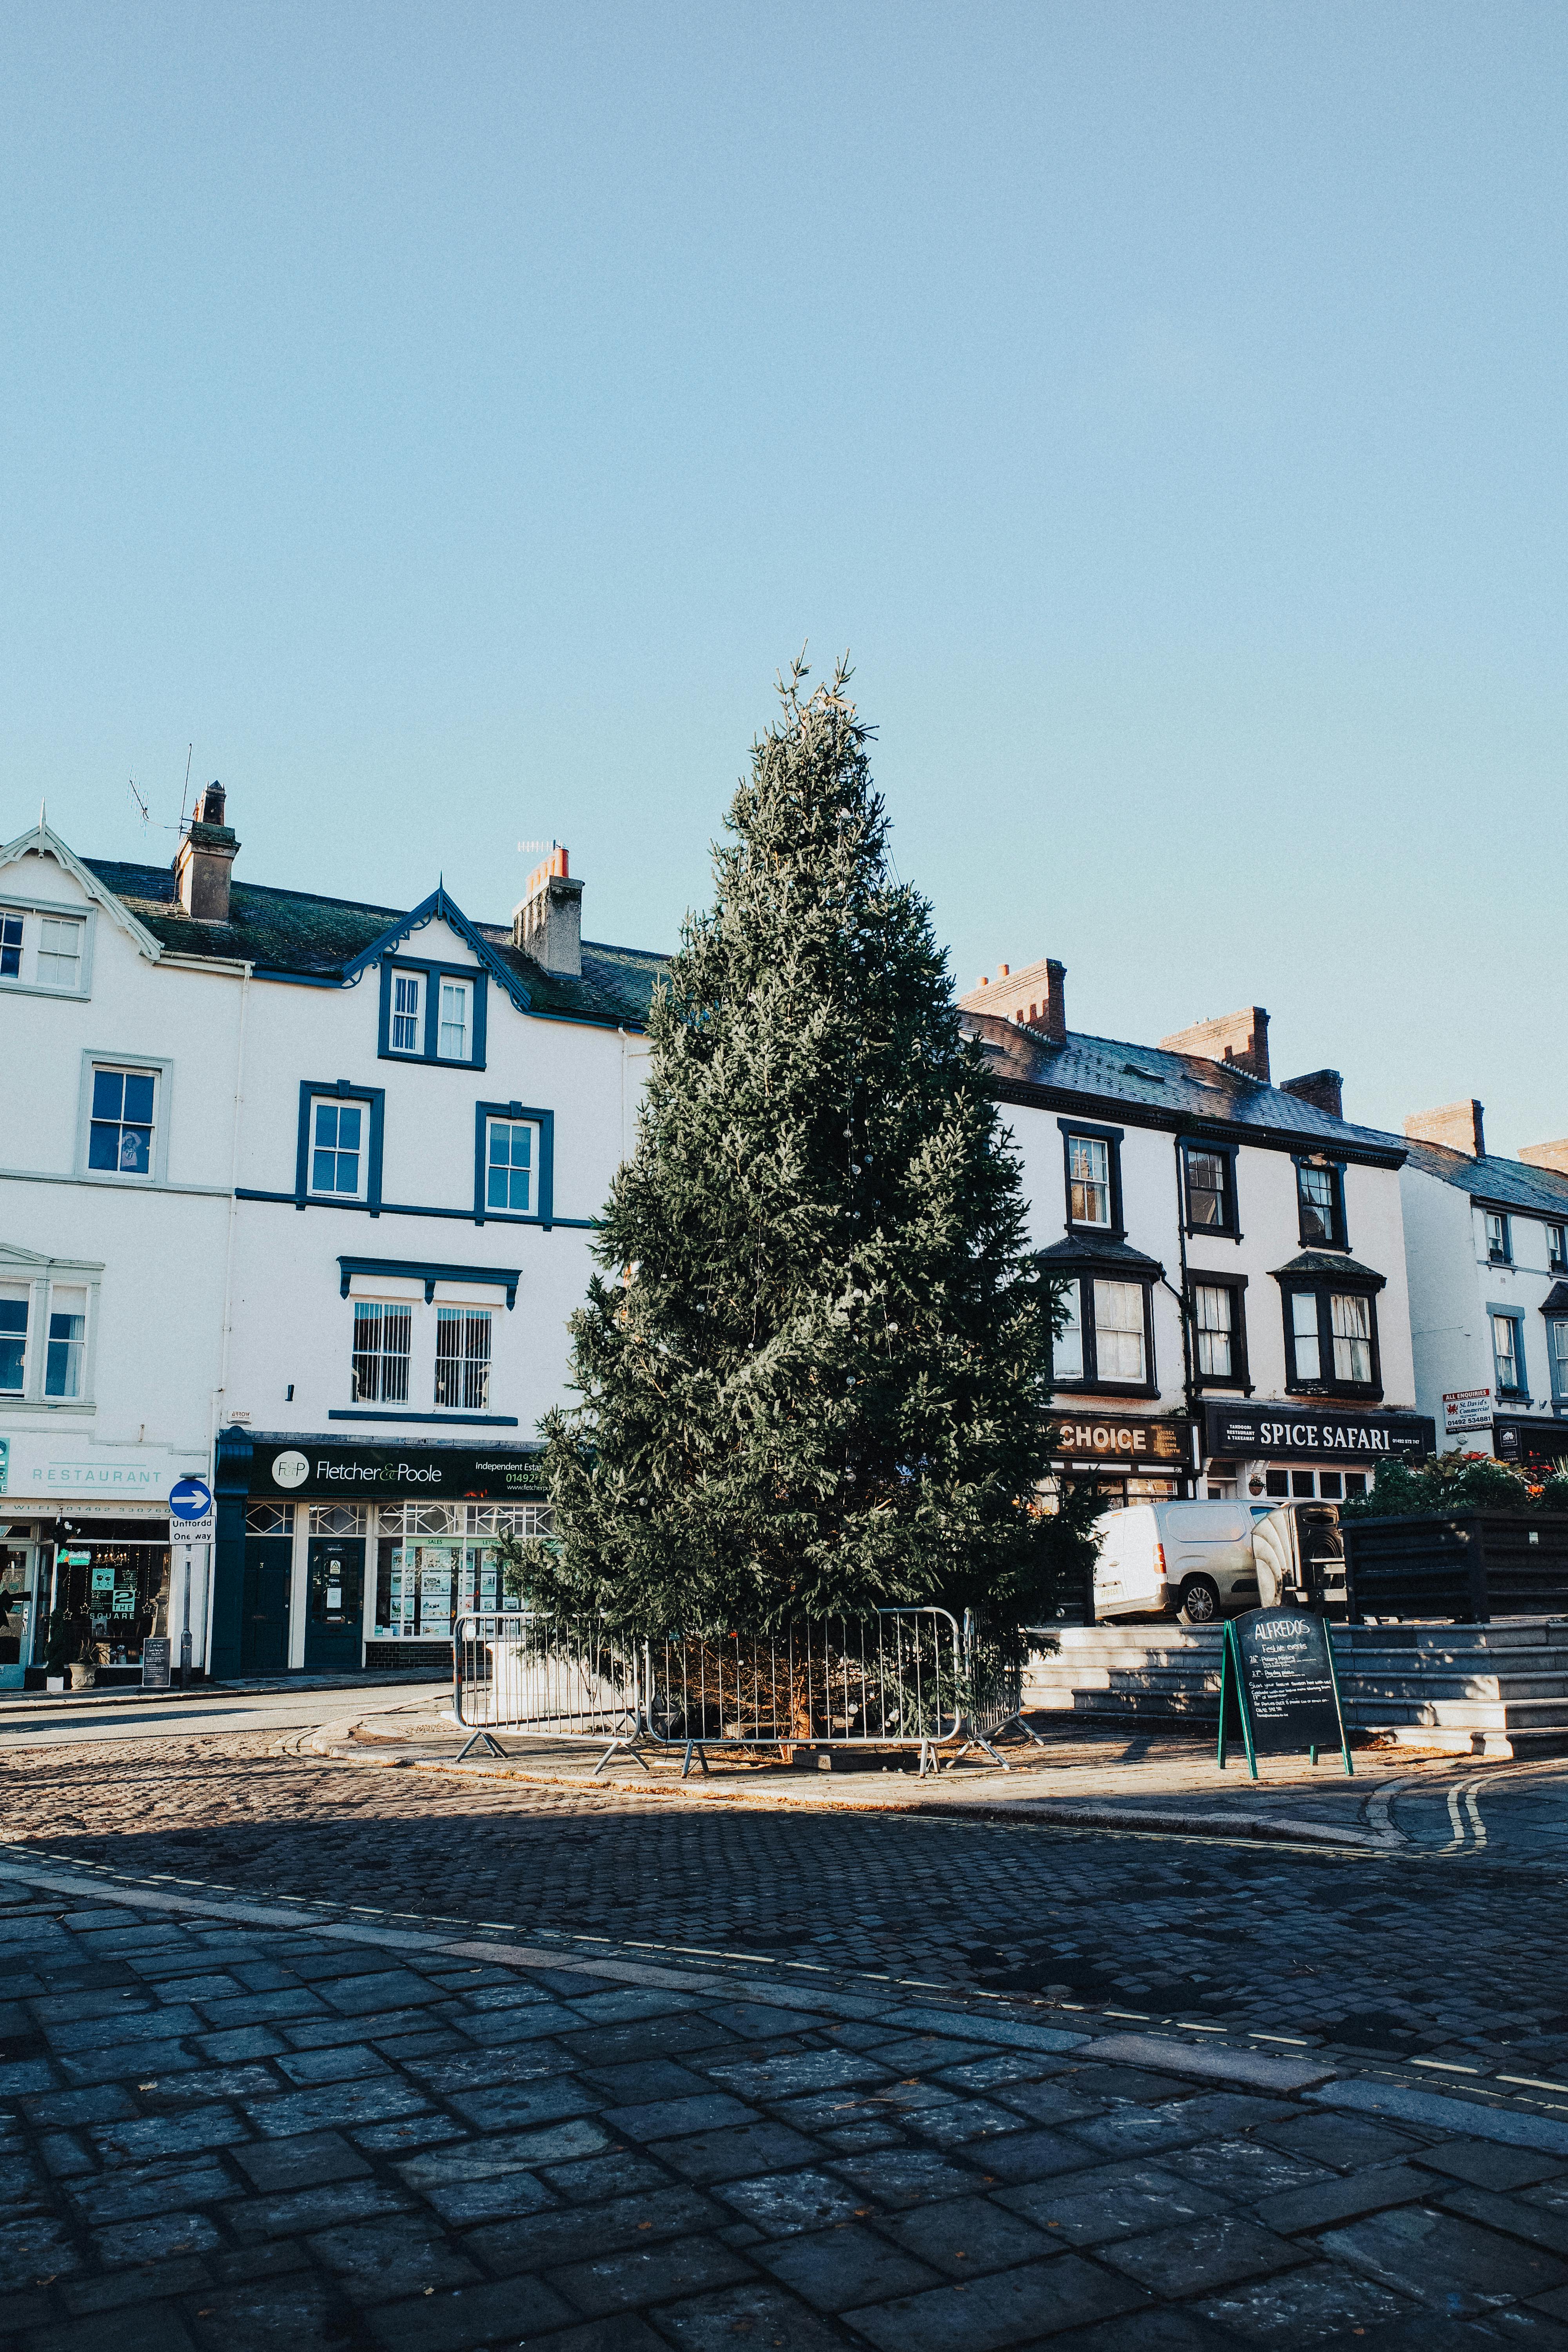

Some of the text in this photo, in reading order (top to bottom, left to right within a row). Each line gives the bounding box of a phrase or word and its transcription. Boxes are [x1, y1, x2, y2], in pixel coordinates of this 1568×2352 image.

[1457, 1390, 1486, 1399] ENQUIRIES
[1459, 1406, 1489, 1414] Commercial
[1060, 1425, 1146, 1450] CHOICE
[1261, 1423, 1390, 1450] SPICE SAFARI
[278, 1461, 305, 1477] F&P
[475, 1462, 523, 1472] Independent
[33, 1469, 161, 1482] RESTAURANT
[506, 1474, 535, 1483] 01492
[114, 1591, 134, 1604] 2
[1255, 1619, 1311, 1640] ALFREDOS
